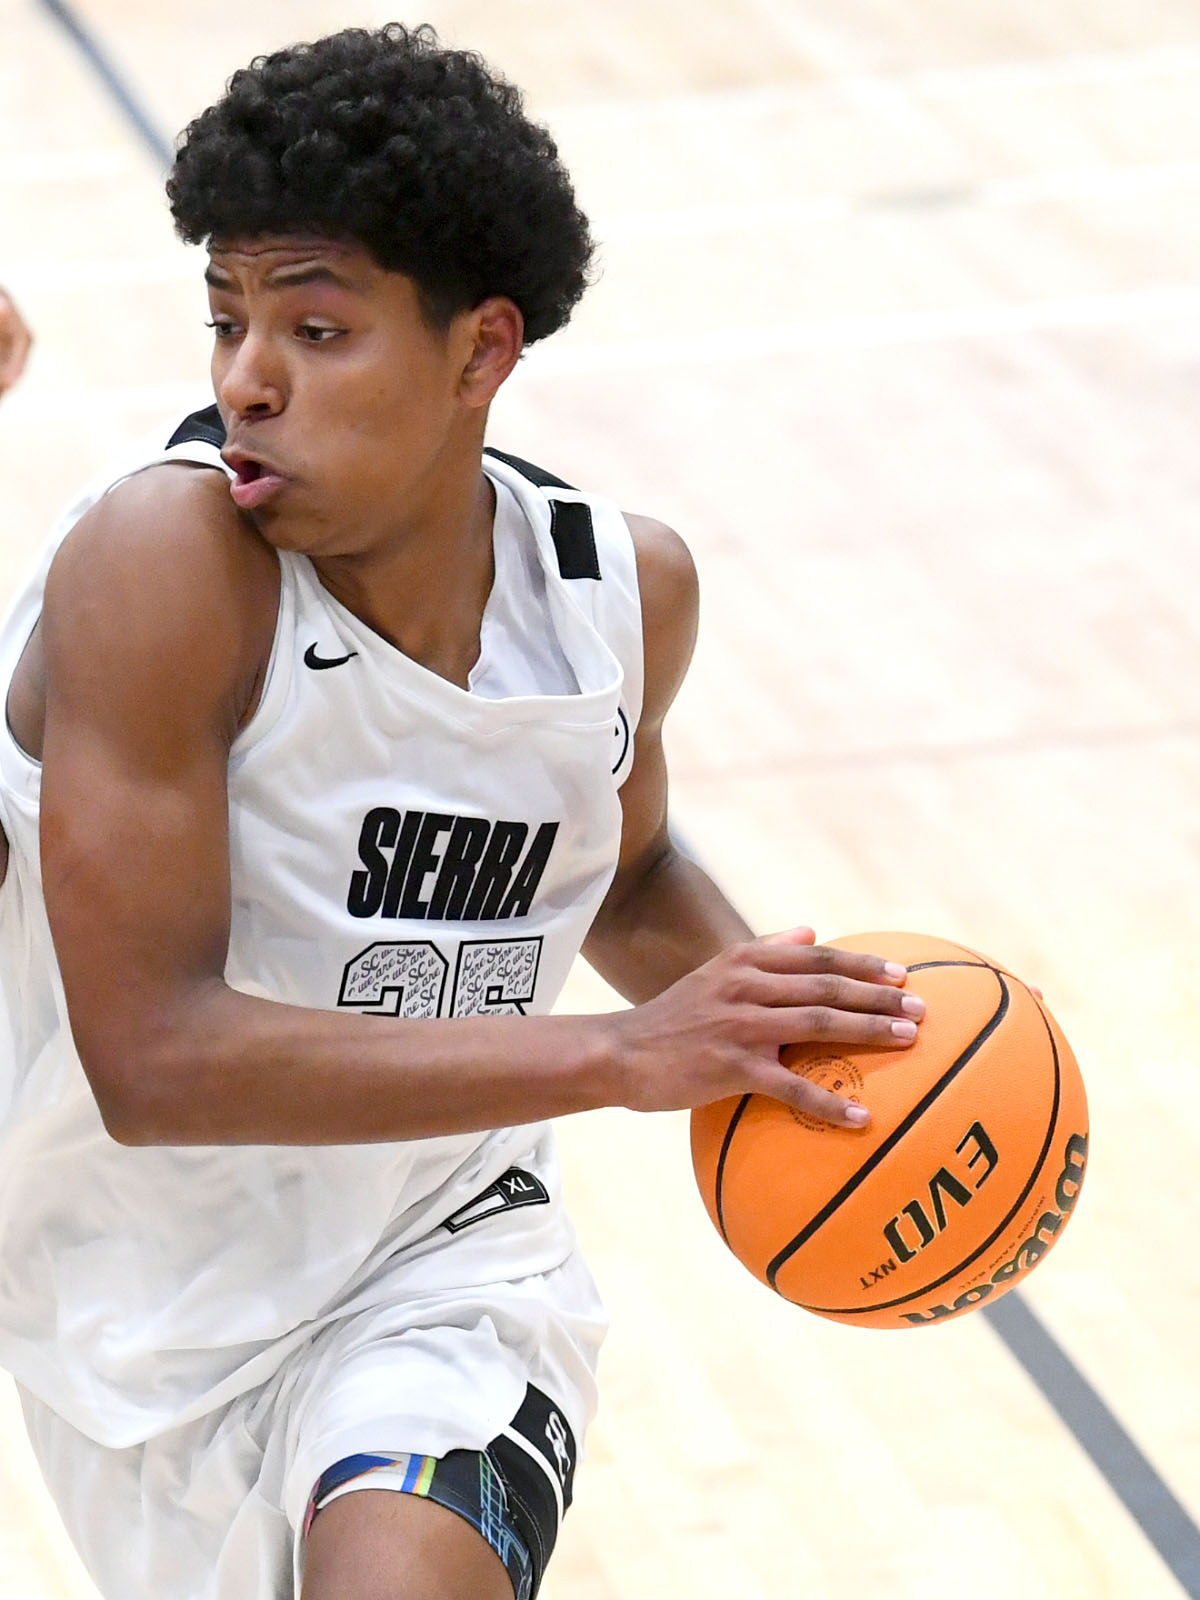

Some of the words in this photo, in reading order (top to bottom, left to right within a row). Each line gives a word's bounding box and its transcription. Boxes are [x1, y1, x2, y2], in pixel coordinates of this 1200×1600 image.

[346, 806, 561, 921] SIERRA
[503, 1176, 535, 1194] XL
[882, 1119, 1000, 1264] EVO
[898, 1132, 1088, 1324] Wilson
[860, 1258, 897, 1290] NXT
